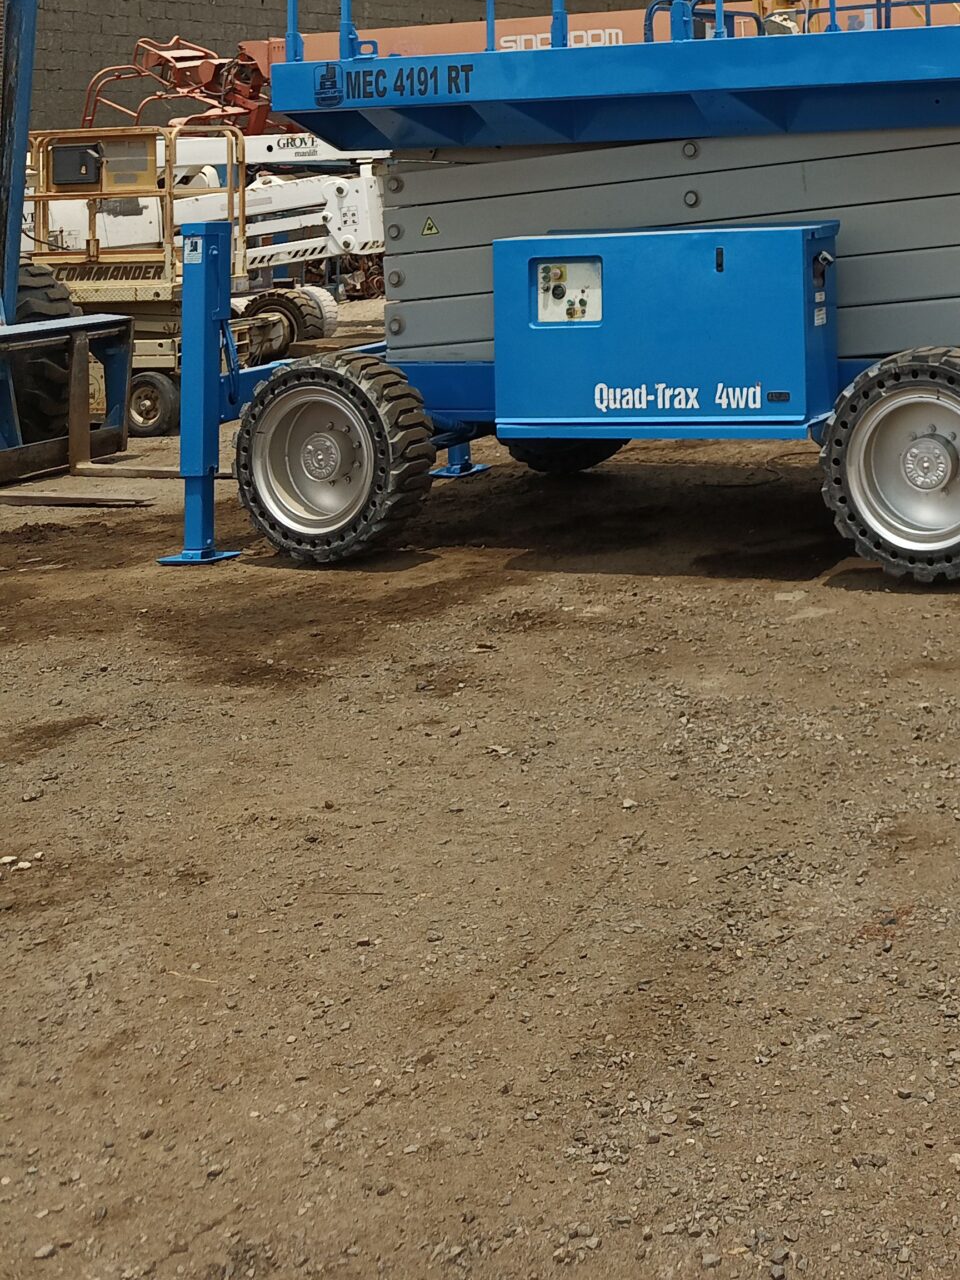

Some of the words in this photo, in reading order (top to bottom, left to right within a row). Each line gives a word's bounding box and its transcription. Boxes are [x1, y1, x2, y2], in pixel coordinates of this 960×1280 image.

[346, 69, 387, 99] MEC
[393, 65, 438, 96] 4191
[447, 64, 473, 94] RT
[277, 136, 318, 148] GROVE
[55, 264, 165, 281] COMMANDER
[594, 382, 700, 412] Quad-Trax
[715, 381, 761, 409] 4wd
